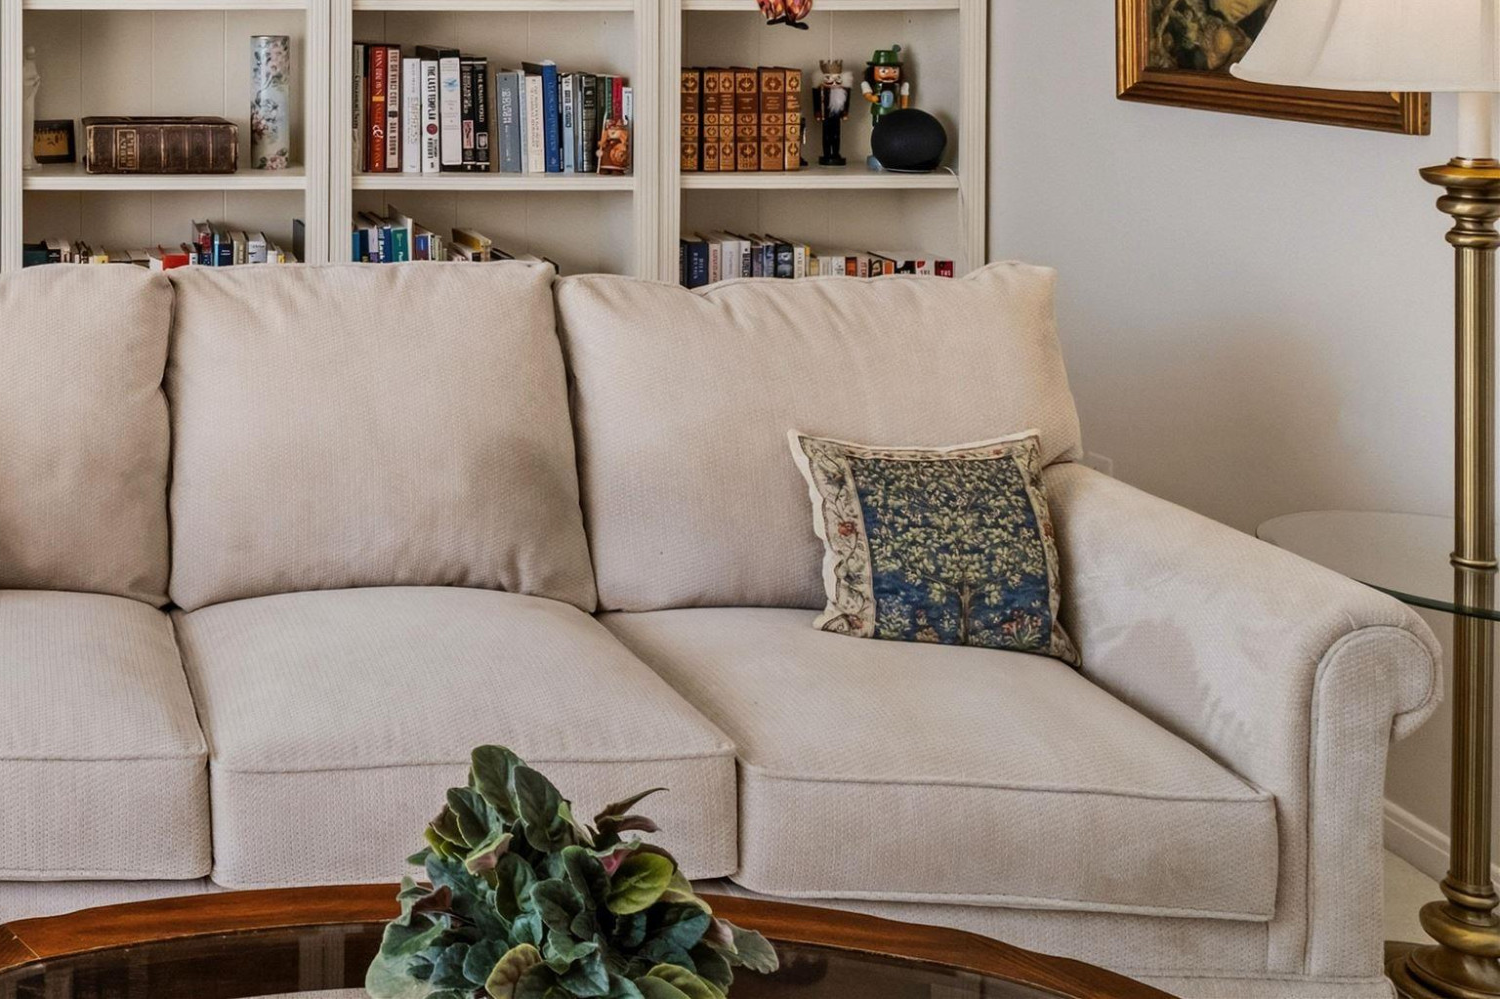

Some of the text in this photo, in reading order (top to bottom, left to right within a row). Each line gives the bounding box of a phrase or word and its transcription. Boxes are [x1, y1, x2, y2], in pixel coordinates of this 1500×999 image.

[375, 50, 383, 67] DAN
[389, 52, 398, 107] THE DA VINCI CODE
[427, 66, 436, 120] THE LAST TEMPLAR
[372, 124, 384, 139] &
[389, 122, 398, 134] DAN
